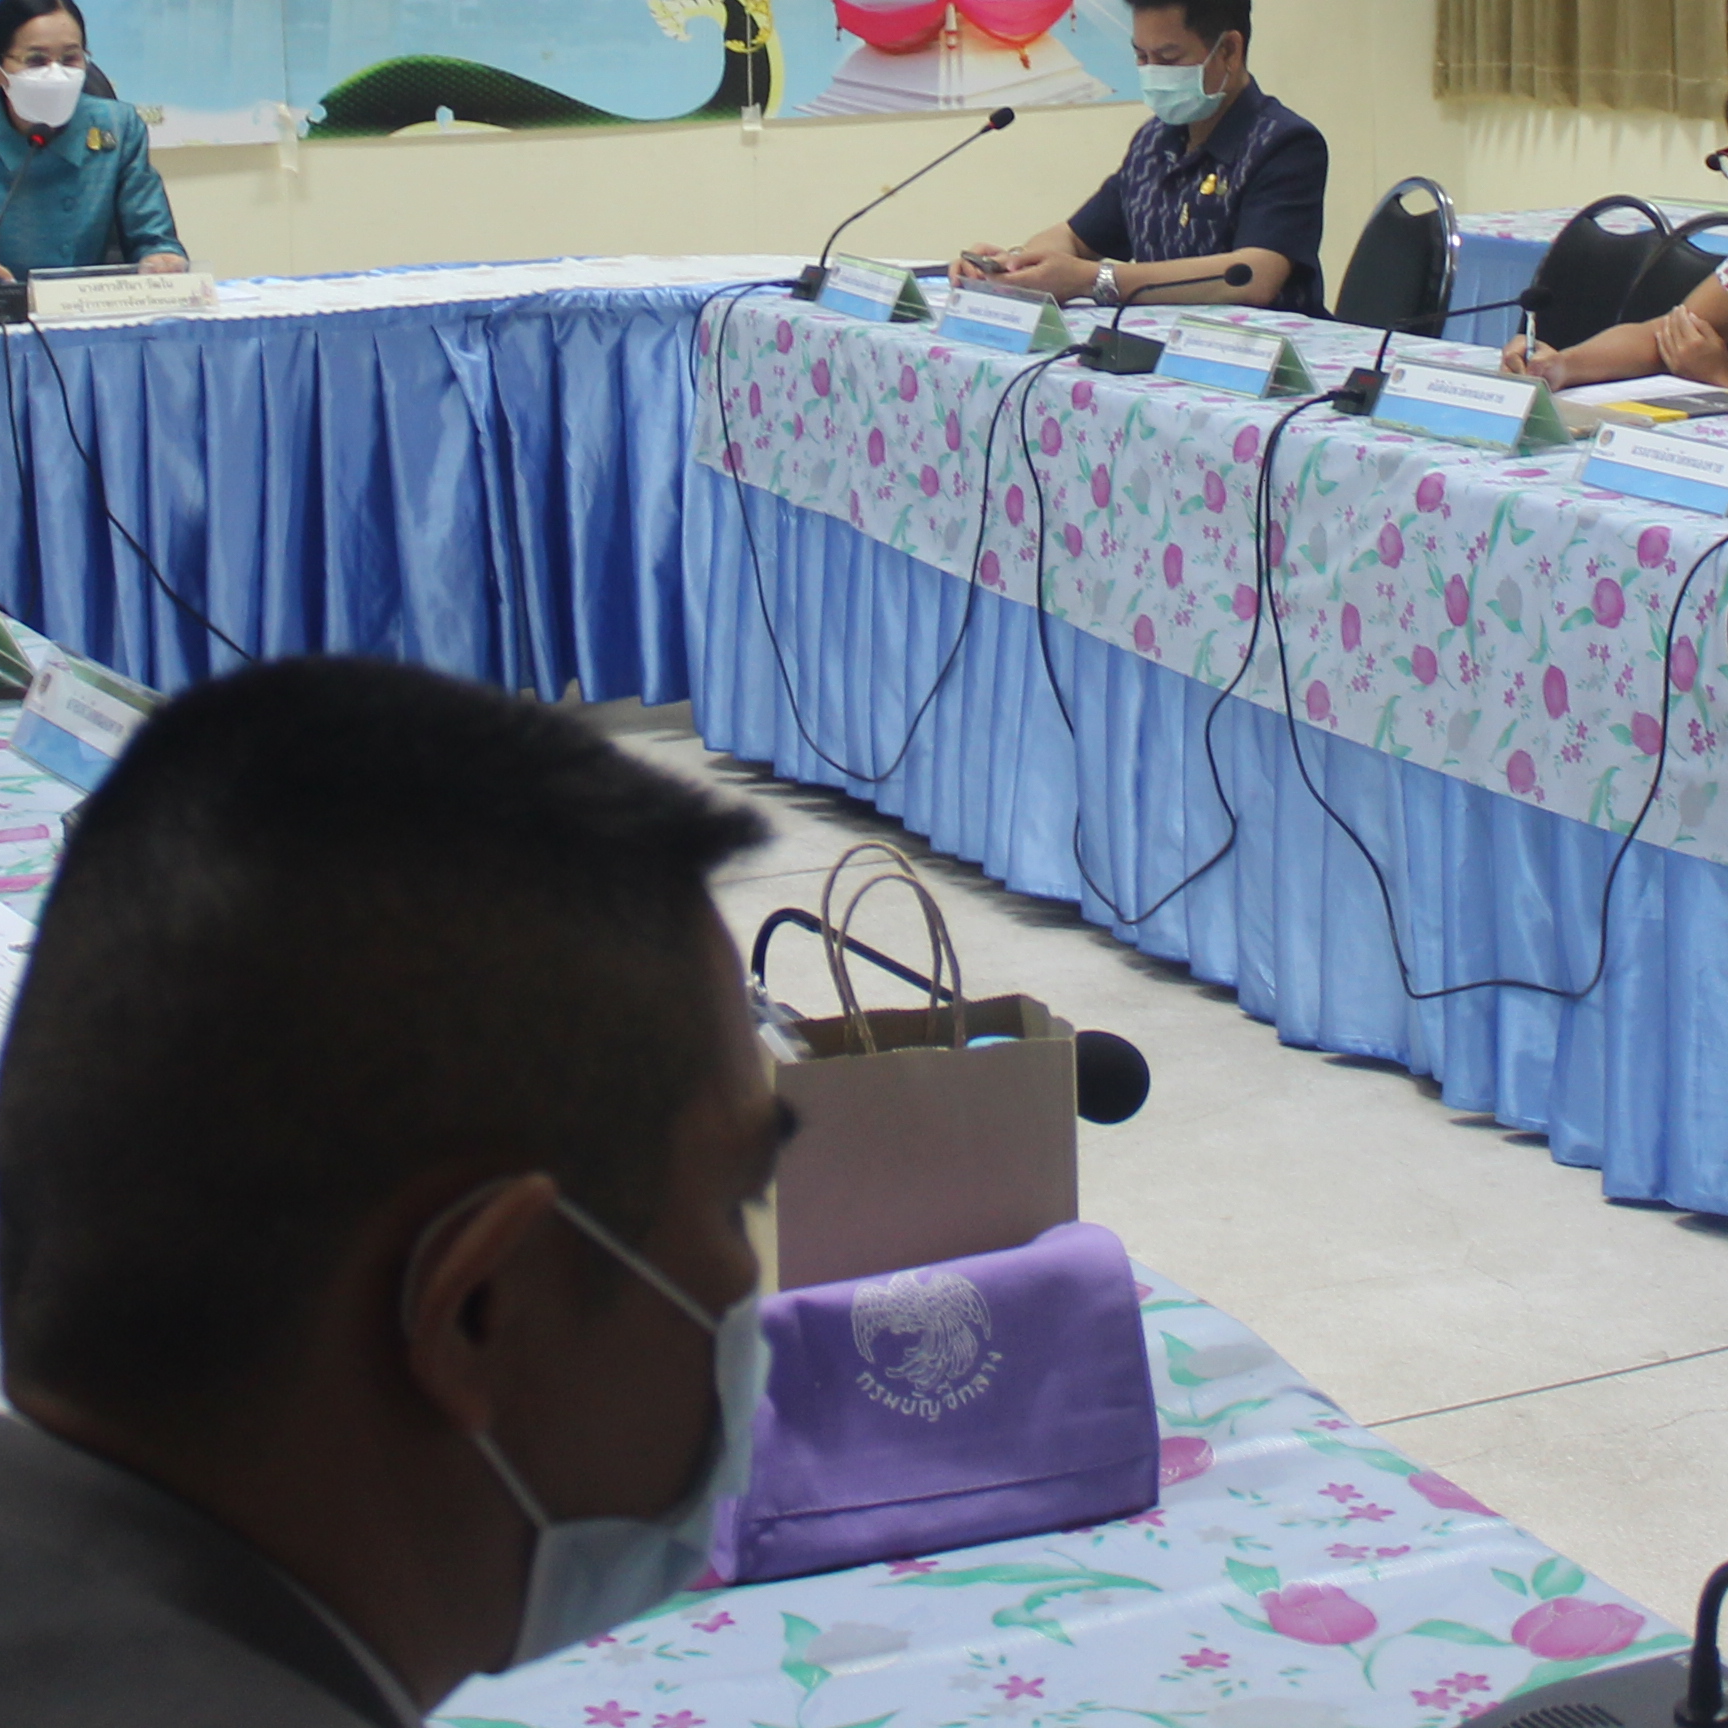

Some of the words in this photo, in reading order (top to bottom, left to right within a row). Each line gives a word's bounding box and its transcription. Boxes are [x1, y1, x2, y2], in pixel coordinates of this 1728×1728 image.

[854, 1349, 1005, 1423] กรมบัญชีกลาง
